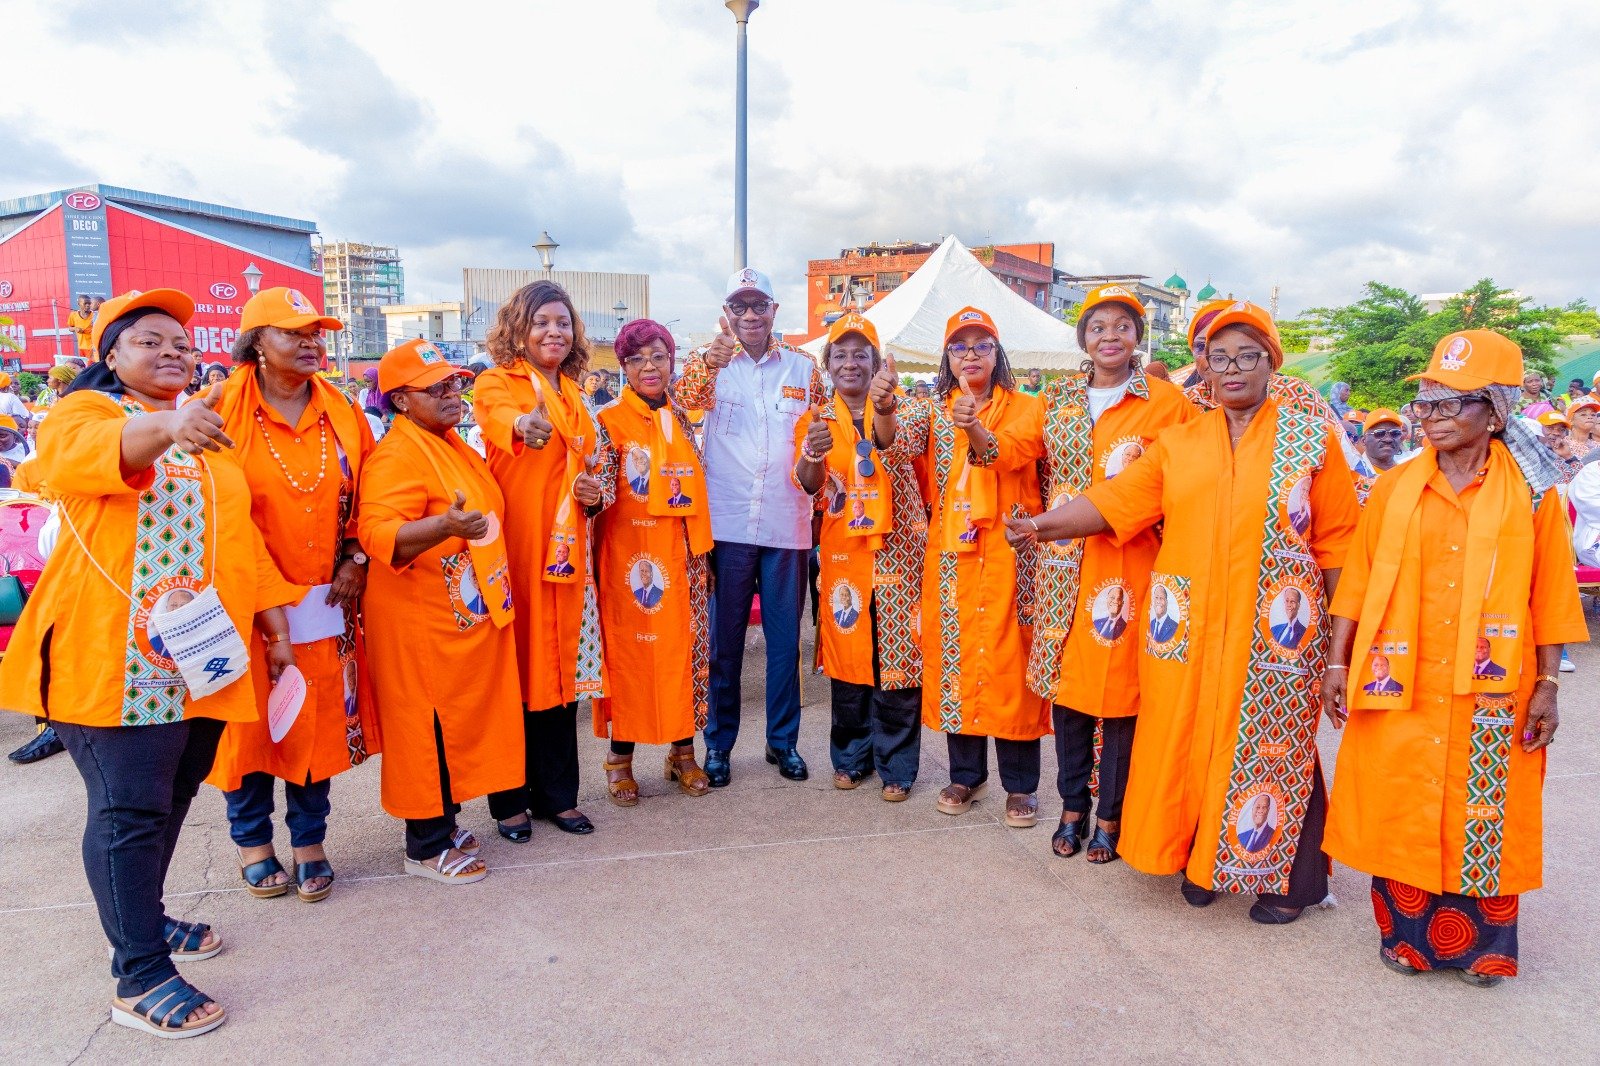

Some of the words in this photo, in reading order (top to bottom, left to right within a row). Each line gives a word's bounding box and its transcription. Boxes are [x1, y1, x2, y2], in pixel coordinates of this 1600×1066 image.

[72, 195, 97, 208] FC
[72, 219, 98, 231] DECO
[214, 285, 234, 297] FC
[195, 303, 215, 314] IRE
[217, 304, 233, 315] DE
[844, 322, 865, 330] ADO
[0, 324, 26, 352] ECO
[1099, 449, 1111, 468] AVEC
[1279, 481, 1292, 505] AVEC
[454, 555, 472, 580] ALASS
[451, 584, 462, 600] AVEC
[1085, 593, 1096, 612] AVEC
[1093, 576, 1127, 594] ALASSANE
[1260, 599, 1272, 619] AVEC
[1269, 576, 1304, 596] ALASSANE
[135, 603, 152, 630] AVEC
[147, 577, 196, 602] ALASSANE
[1089, 628, 1125, 648] PRESIDENT
[146, 652, 178, 669] PRESI
[575, 681, 602, 691] RHDP
[950, 675, 960, 701] RHDP
[1475, 692, 1518, 709] RESIDENT
[1259, 745, 1286, 755] RHDP
[1229, 807, 1240, 826] AVEC
[1240, 784, 1273, 806] ALASSANE
[1465, 806, 1497, 817] RHDP
[1234, 844, 1272, 864] PRESIDENT
